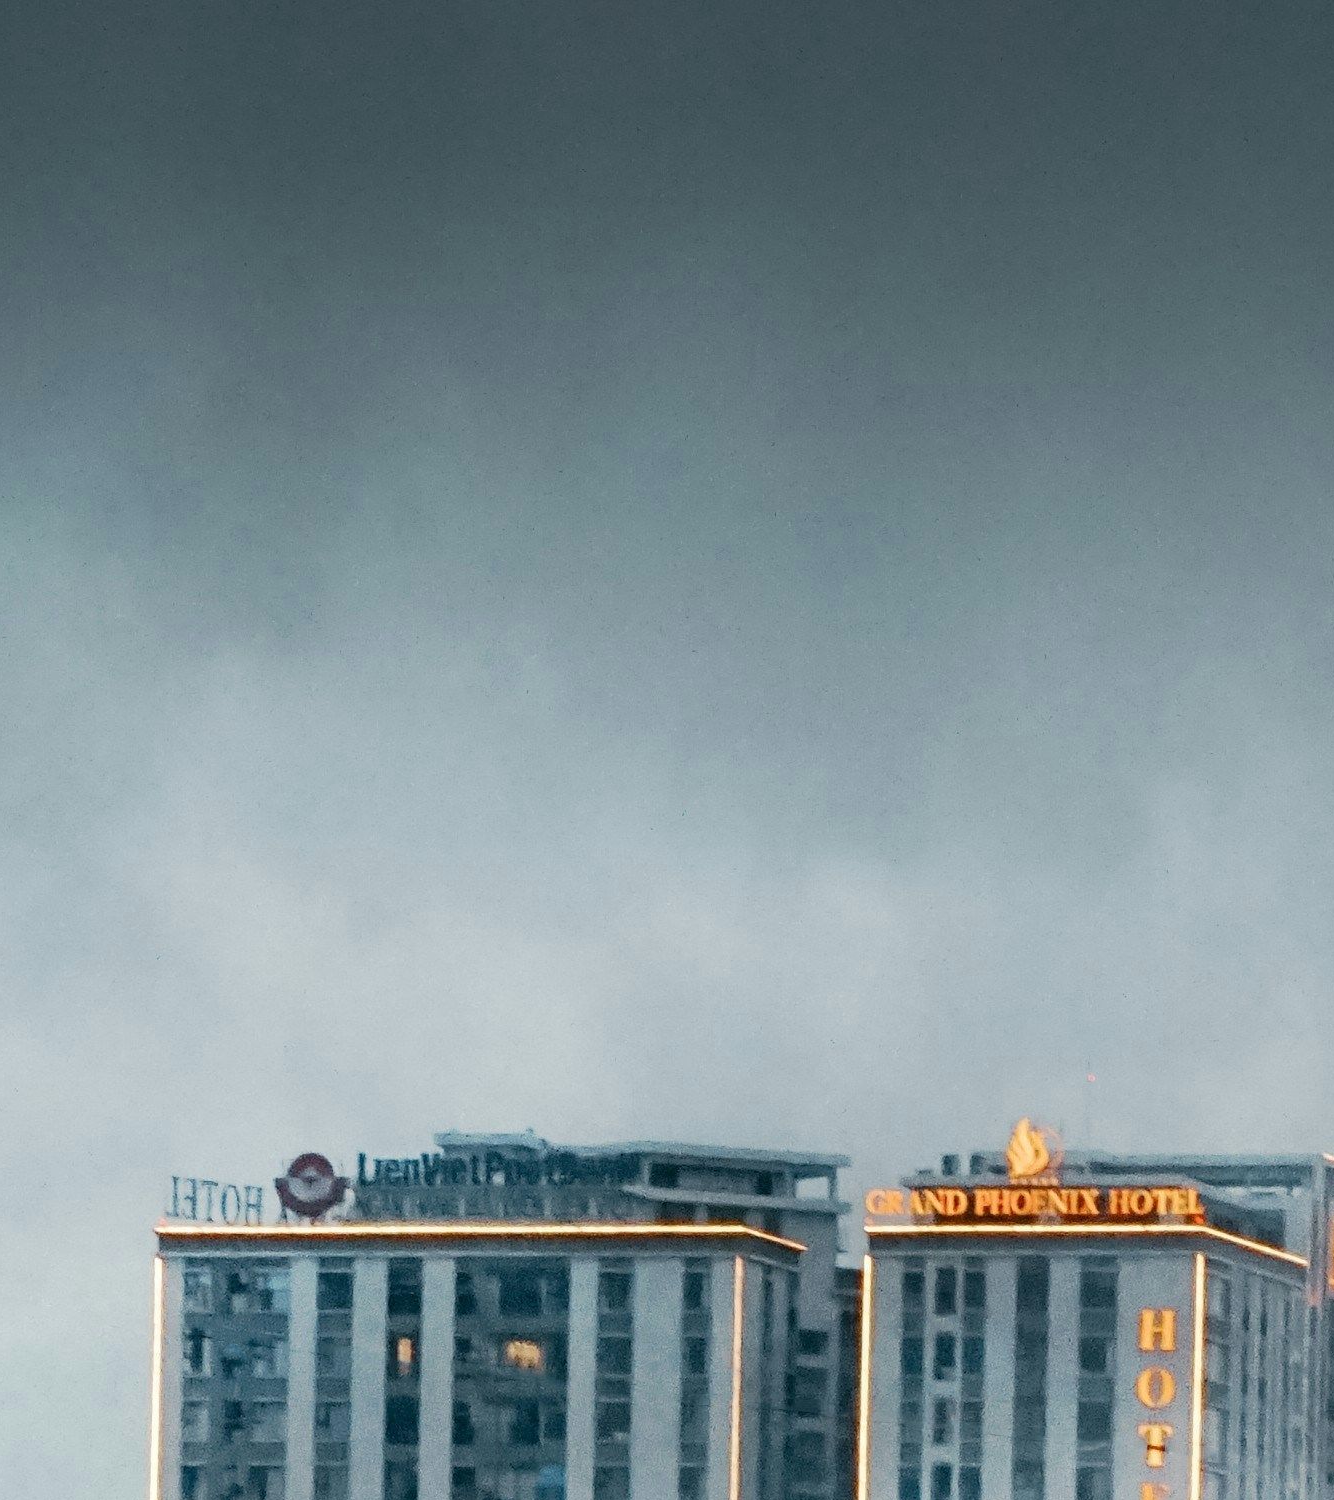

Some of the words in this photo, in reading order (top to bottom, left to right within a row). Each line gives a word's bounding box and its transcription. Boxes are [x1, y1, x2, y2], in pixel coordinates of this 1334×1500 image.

[866, 1189, 968, 1216] GRAND
[974, 1188, 1100, 1216] PHOENIX
[1109, 1188, 1203, 1216] HOTEL
